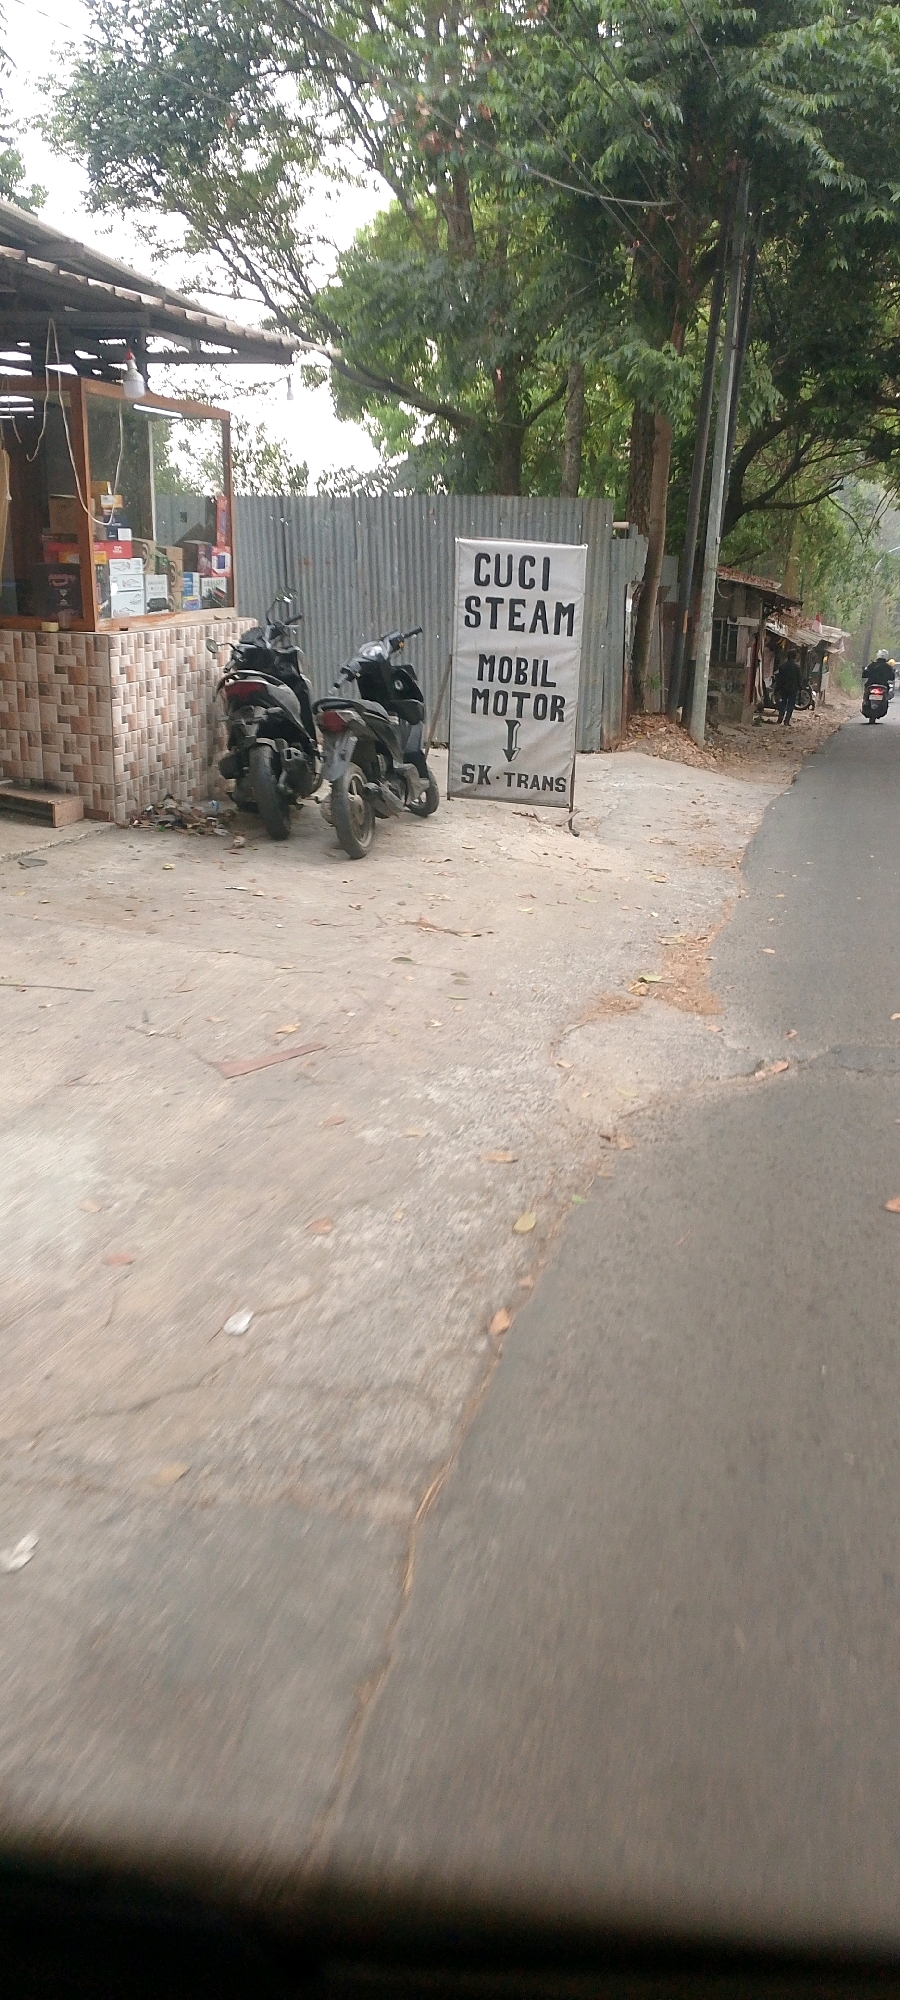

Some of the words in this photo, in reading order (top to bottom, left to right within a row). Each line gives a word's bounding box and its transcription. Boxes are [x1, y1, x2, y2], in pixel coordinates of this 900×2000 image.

[473, 552, 552, 592] CUCI
[463, 595, 576, 637] STEAM
[476, 653, 557, 688] MOBIL
[470, 687, 567, 723] MOTOR
